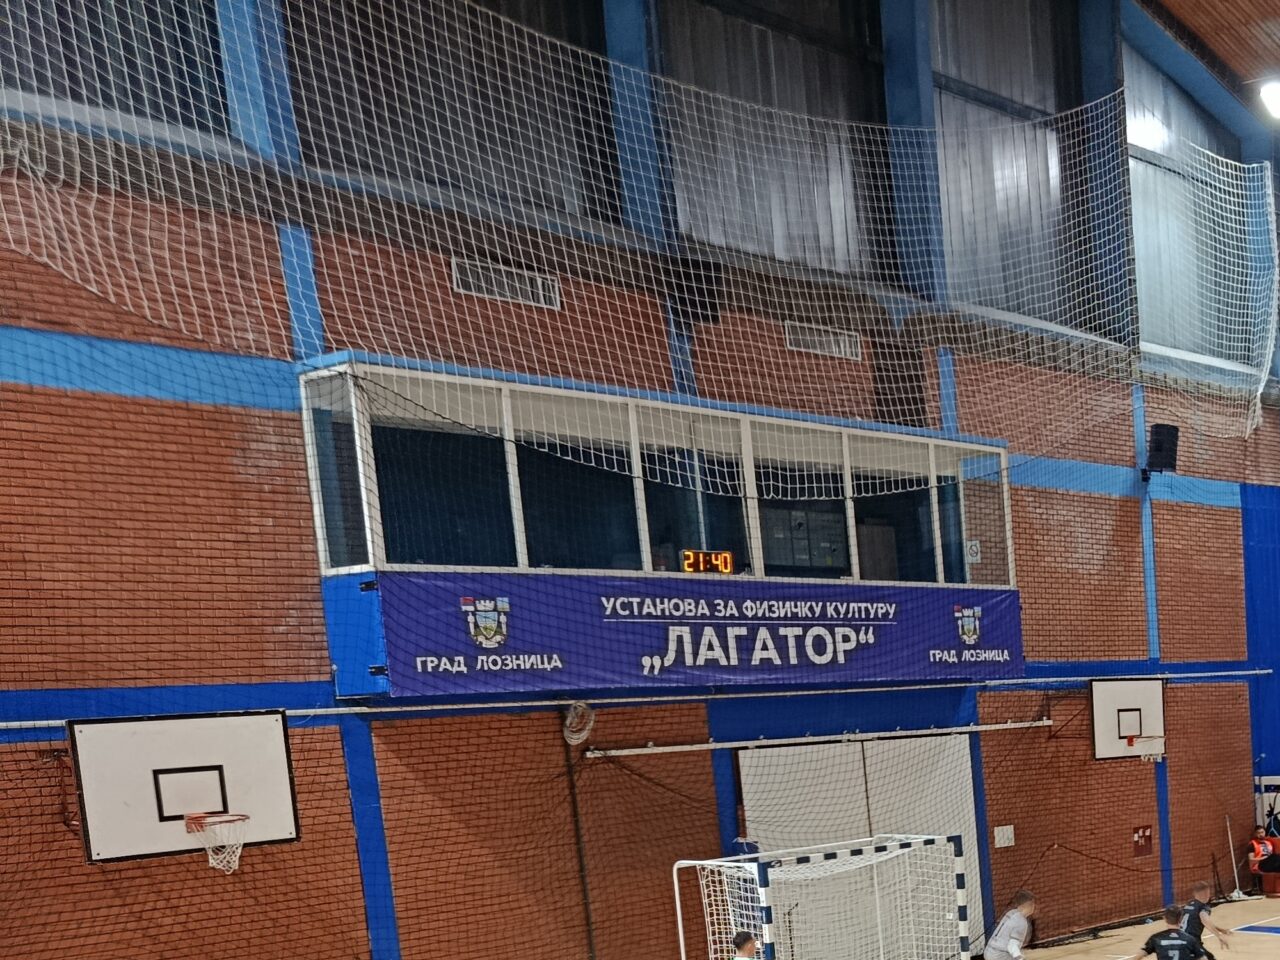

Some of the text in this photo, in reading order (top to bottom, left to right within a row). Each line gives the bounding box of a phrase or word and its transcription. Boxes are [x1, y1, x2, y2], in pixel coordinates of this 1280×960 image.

[684, 551, 731, 573] 21:40
[601, 596, 896, 619] УСТАНОВА ЗА ФИЗИЧКУ КУЛТУРУ
[641, 625, 875, 675] „ЛАГАТОР“
[929, 649, 1010, 663] ГРАД ЛОЗНИЦА
[415, 654, 562, 674] ГРАД ЛОЗНИЦА
